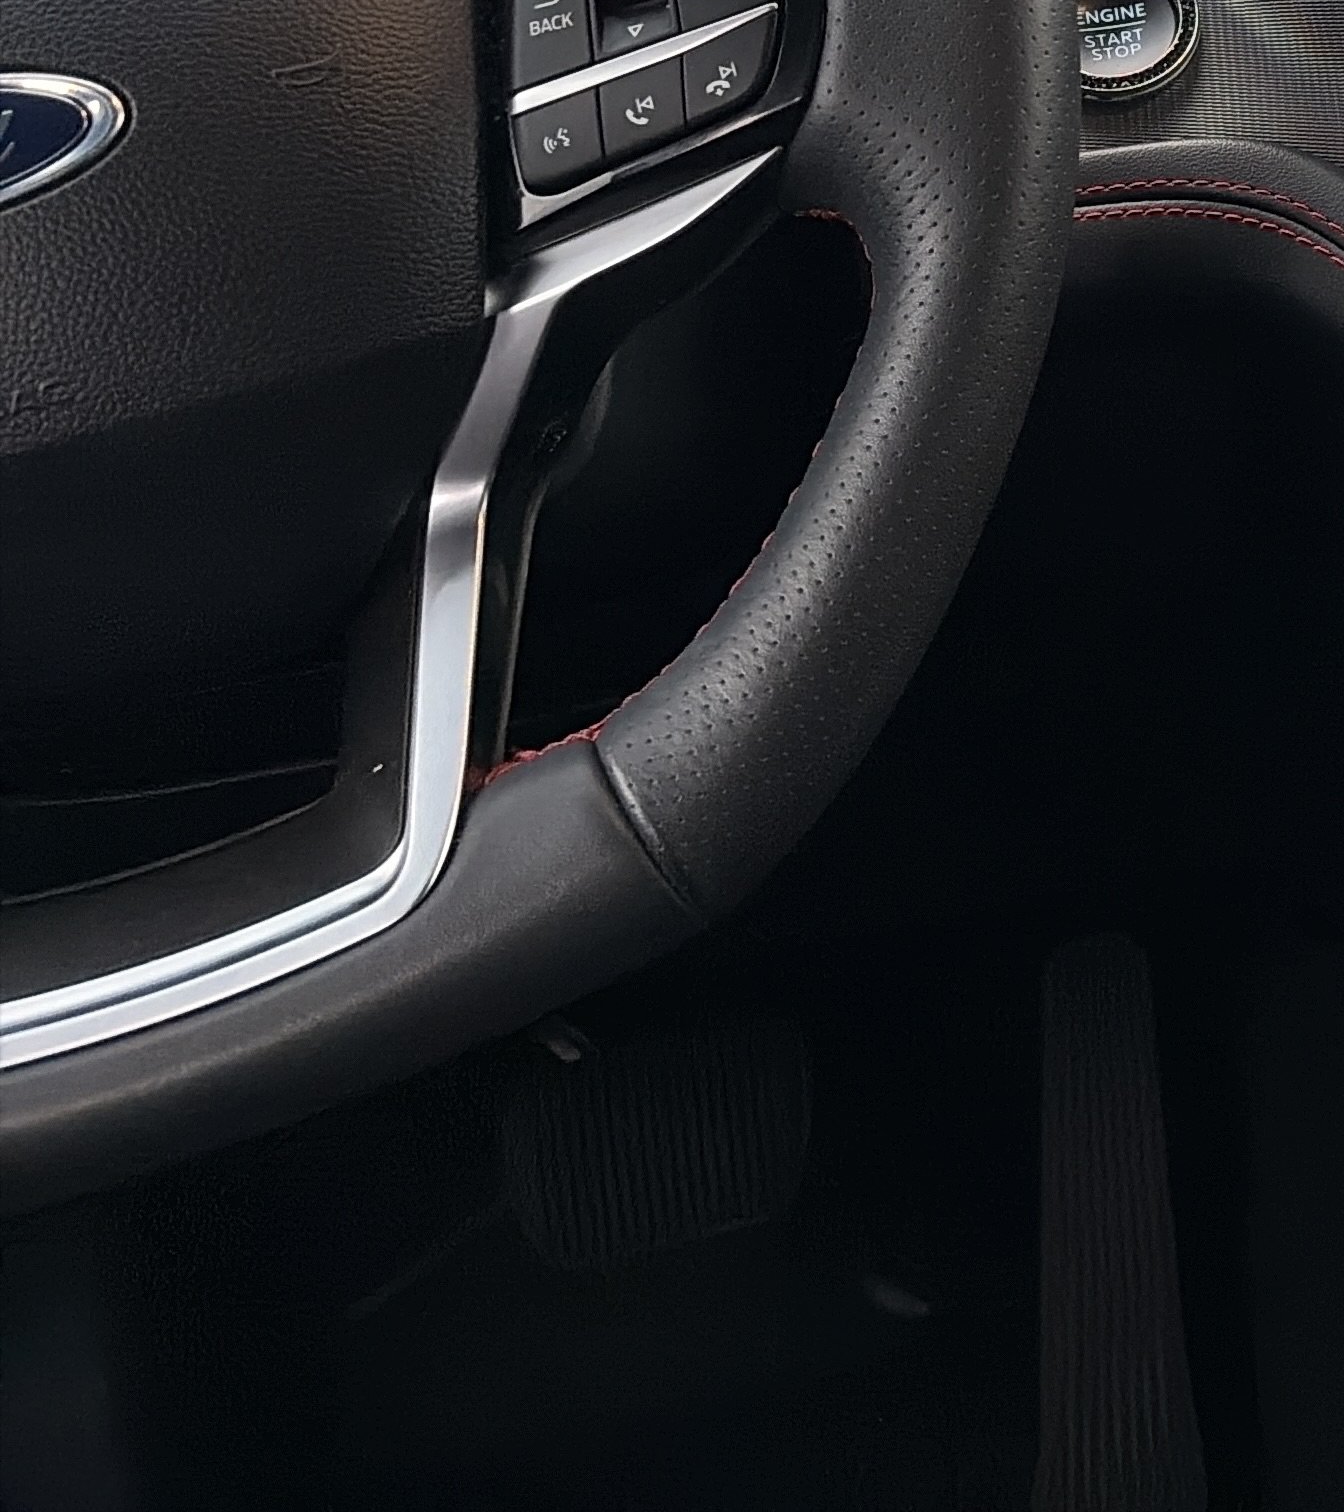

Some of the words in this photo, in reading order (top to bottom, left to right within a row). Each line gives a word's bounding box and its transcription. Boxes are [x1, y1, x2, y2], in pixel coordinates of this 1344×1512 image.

[529, 12, 574, 36] BACK
[1077, 2, 1147, 26] ENGINE
[1084, 28, 1144, 48] START
[1091, 43, 1142, 61] STOP
